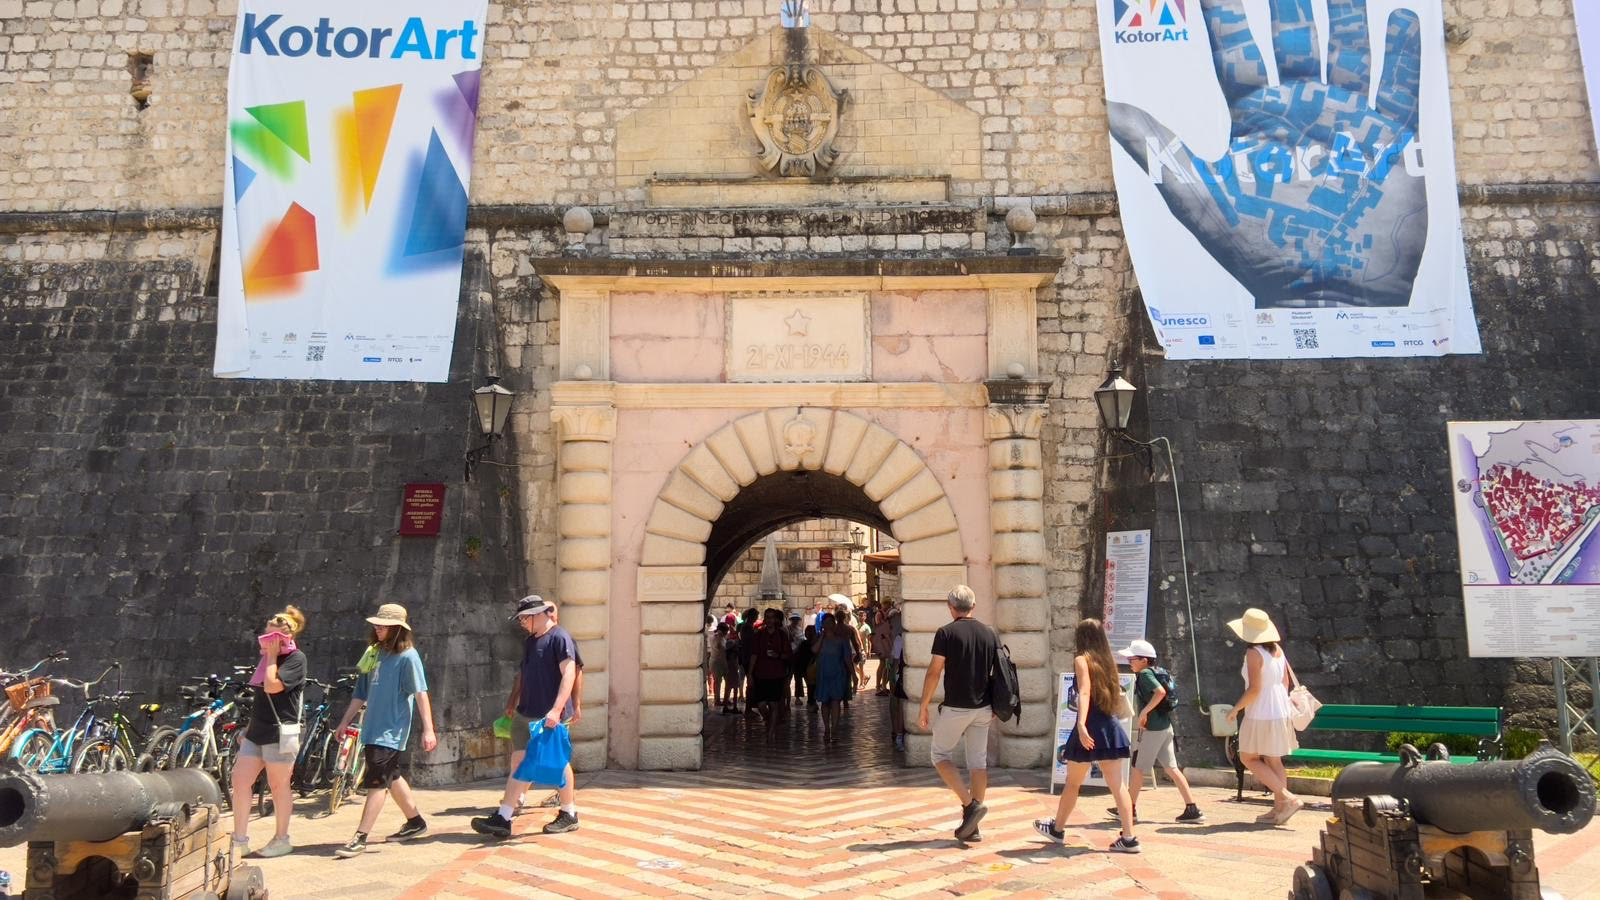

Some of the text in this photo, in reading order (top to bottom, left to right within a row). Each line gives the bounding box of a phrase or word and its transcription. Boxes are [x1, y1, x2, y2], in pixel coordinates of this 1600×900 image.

[240, 13, 478, 59] KotorArt
[1115, 28, 1189, 43] KotorArt
[1161, 317, 1207, 326] unesco
[745, 344, 849, 369] 21-XI-1944
